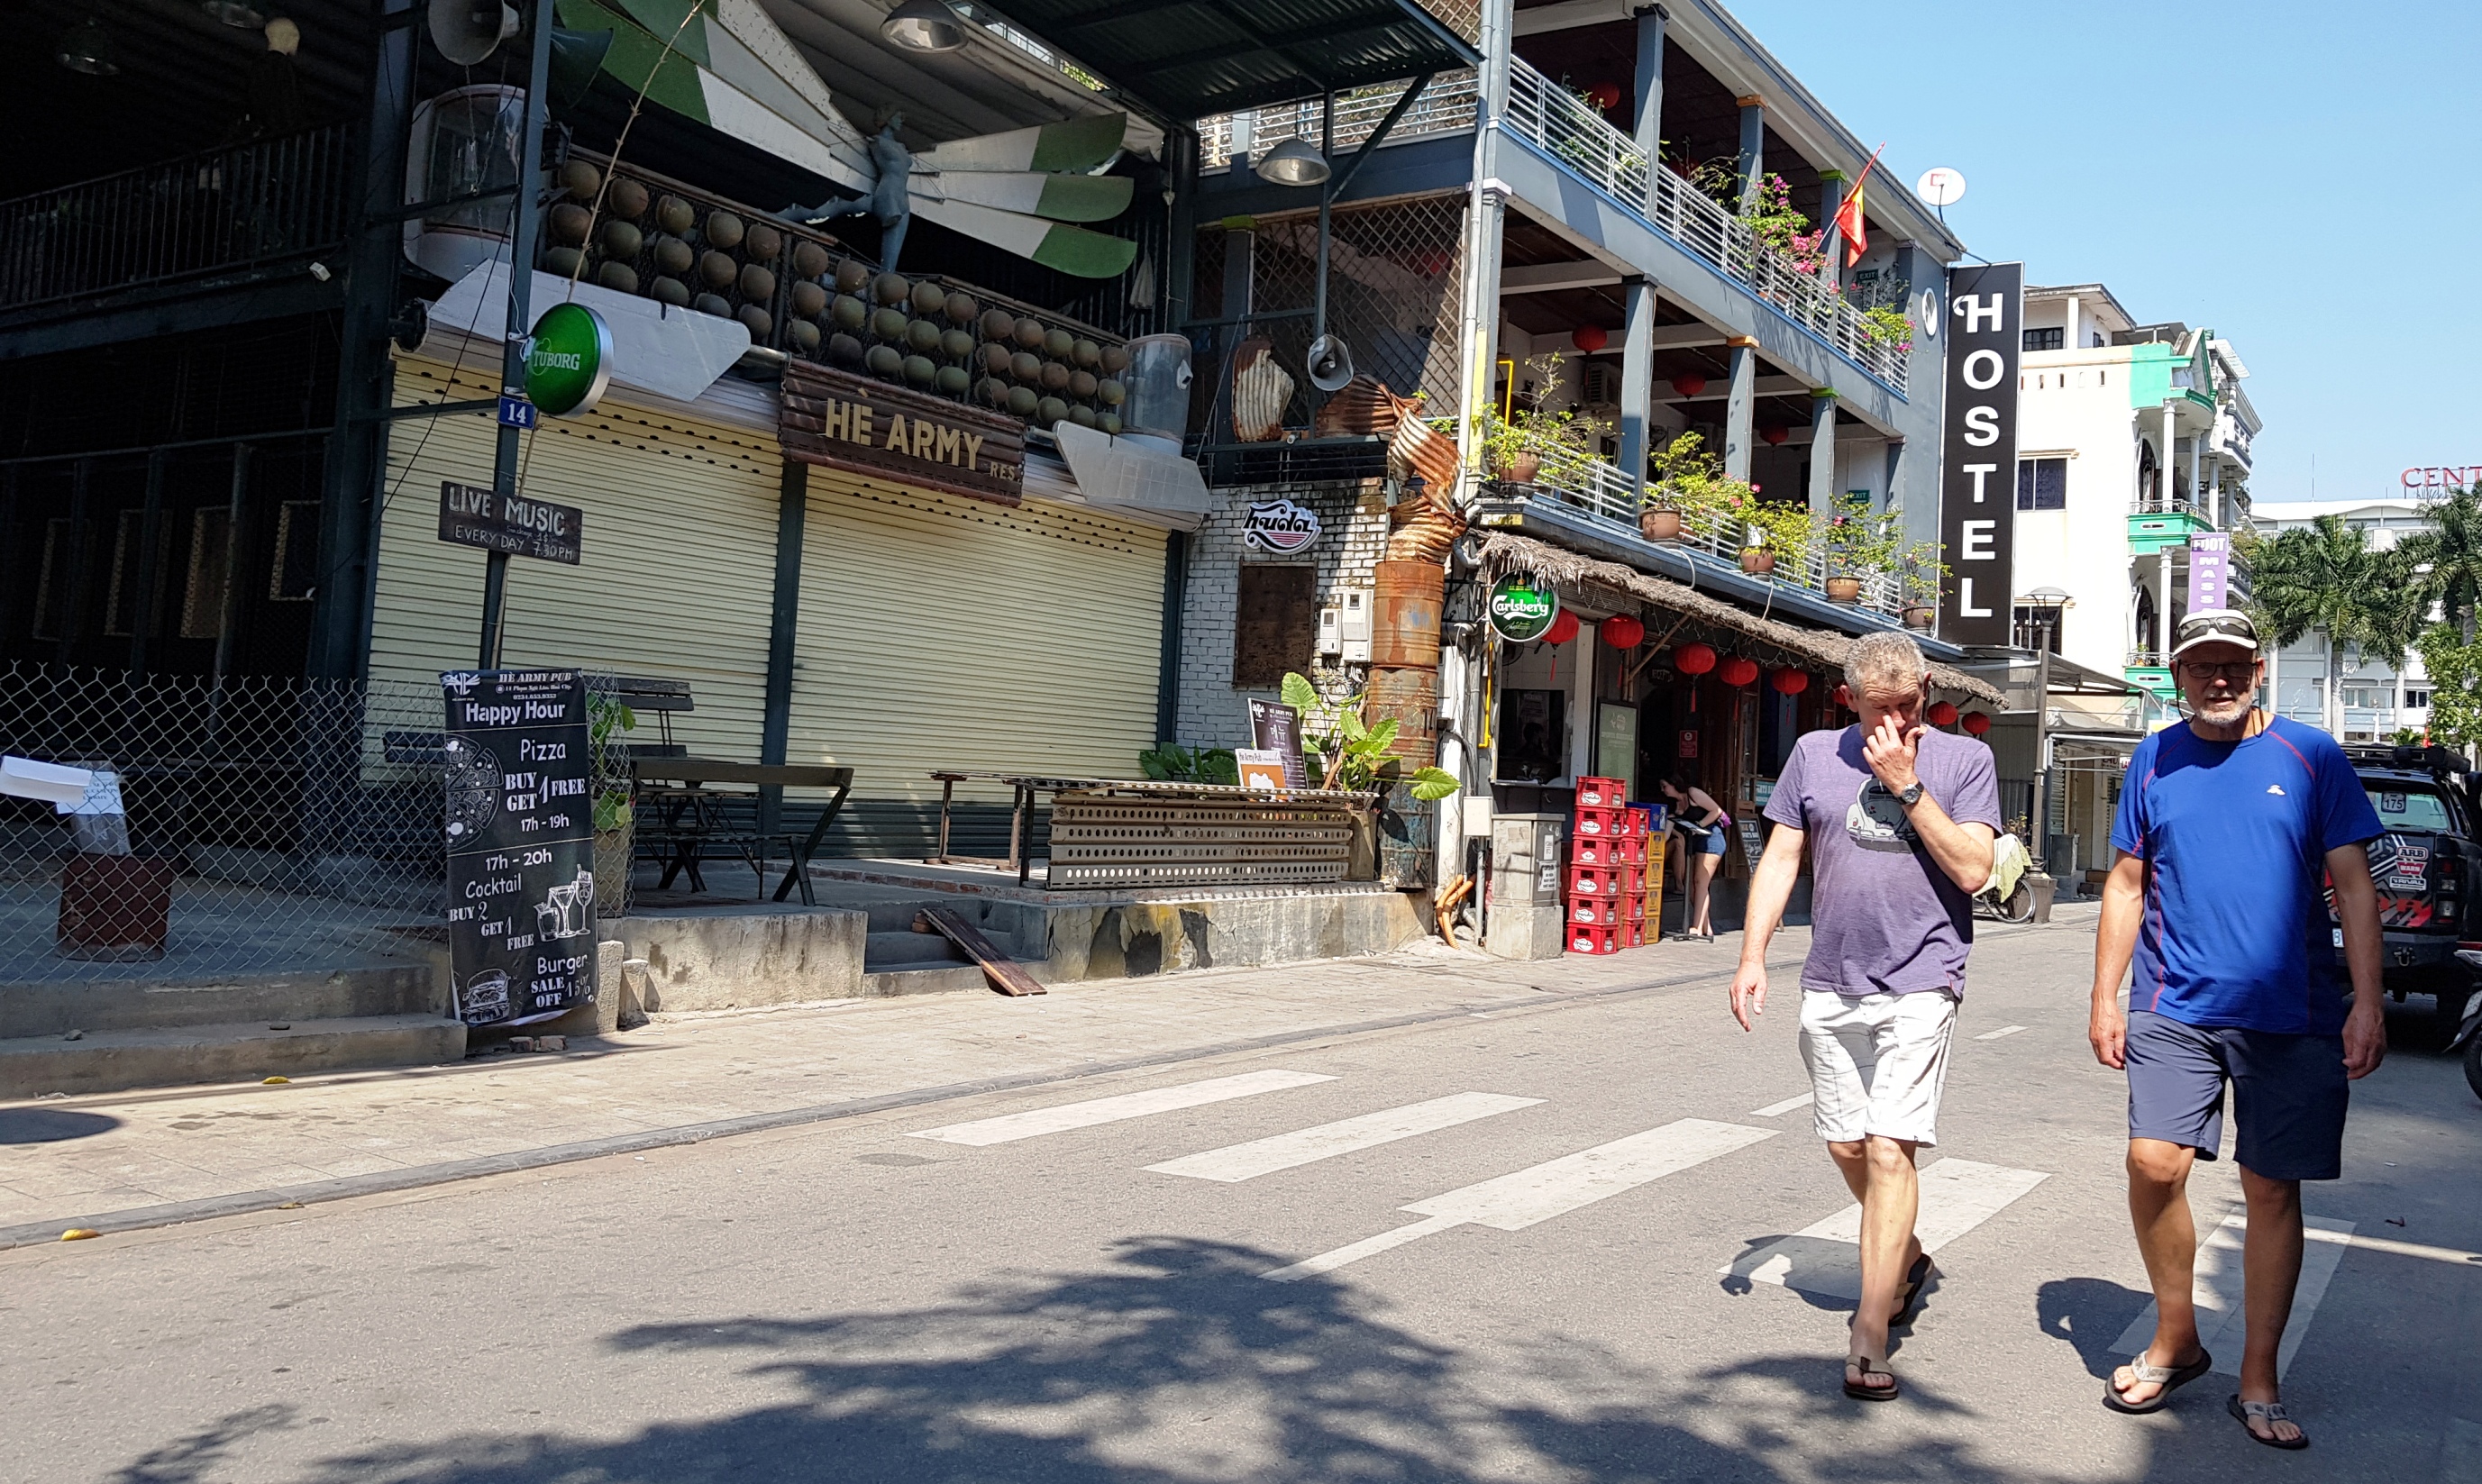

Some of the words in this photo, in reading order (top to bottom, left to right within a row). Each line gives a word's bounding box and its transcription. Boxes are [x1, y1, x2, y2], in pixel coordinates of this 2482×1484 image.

[534, 351, 581, 371] TUBORG
[507, 403, 527, 424] 14
[885, 413, 984, 471] ARMY
[1952, 292, 2005, 618] HOSTEL
[448, 486, 492, 519] LIVE
[504, 496, 565, 536] MUSIC
[1244, 504, 1315, 535] huda
[454, 524, 497, 543] EVERY
[500, 535, 525, 551] DAY
[2193, 537, 2226, 551] FOOT
[2198, 556, 2220, 612] MASS
[1492, 595, 1549, 618] Carlsberg
[517, 672, 549, 683] ARMY
[550, 672, 572, 682] PUB
[465, 703, 521, 726] Happy
[525, 701, 566, 720] Hour
[520, 738, 567, 762] Pizza
[505, 771, 538, 791] BUY
[506, 793, 538, 812] GET
[538, 775, 549, 804] 1
[551, 778, 586, 797] FREE
[2384, 798, 2403, 809] 175
[520, 815, 539, 833] 17h
[549, 813, 570, 829] 19h
[485, 853, 508, 871] 17h
[523, 848, 552, 867] 20h
[2400, 849, 2424, 858] ARB
[465, 872, 522, 899] Cocktail
[450, 906, 475, 923] BUY
[478, 901, 488, 921] 2
[480, 921, 504, 937] GET
[505, 915, 512, 935] 1
[506, 933, 534, 951] FREE
[537, 953, 588, 975] Burger
[530, 976, 565, 994] SALE
[565, 973, 591, 997] 15%
[535, 992, 562, 1008] OFF
